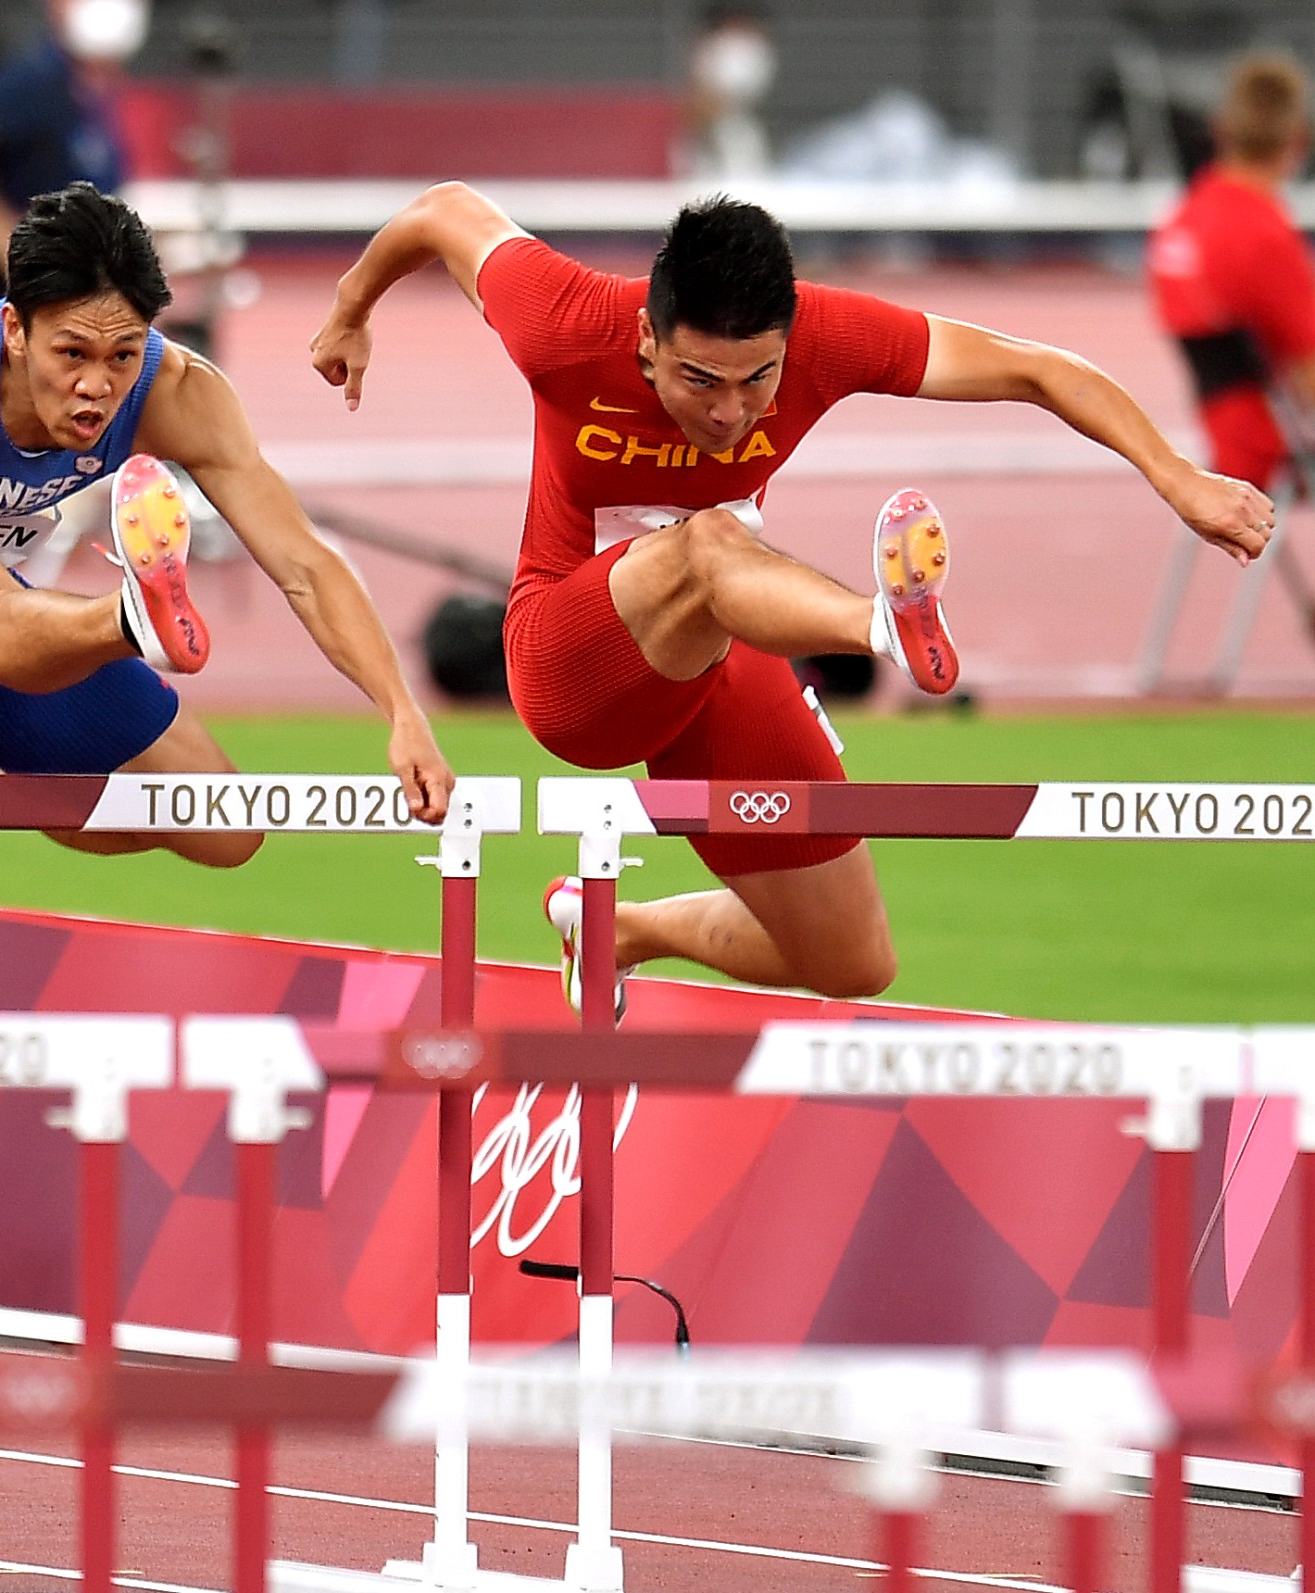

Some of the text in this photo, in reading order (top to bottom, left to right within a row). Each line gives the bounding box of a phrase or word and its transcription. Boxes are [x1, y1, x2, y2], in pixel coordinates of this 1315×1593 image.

[576, 424, 777, 467] CHINA
[141, 784, 414, 828] TOKYO 2020
[1071, 791, 1313, 835] TOKYO 202
[809, 1038, 1123, 1095] TOKYO 2020
